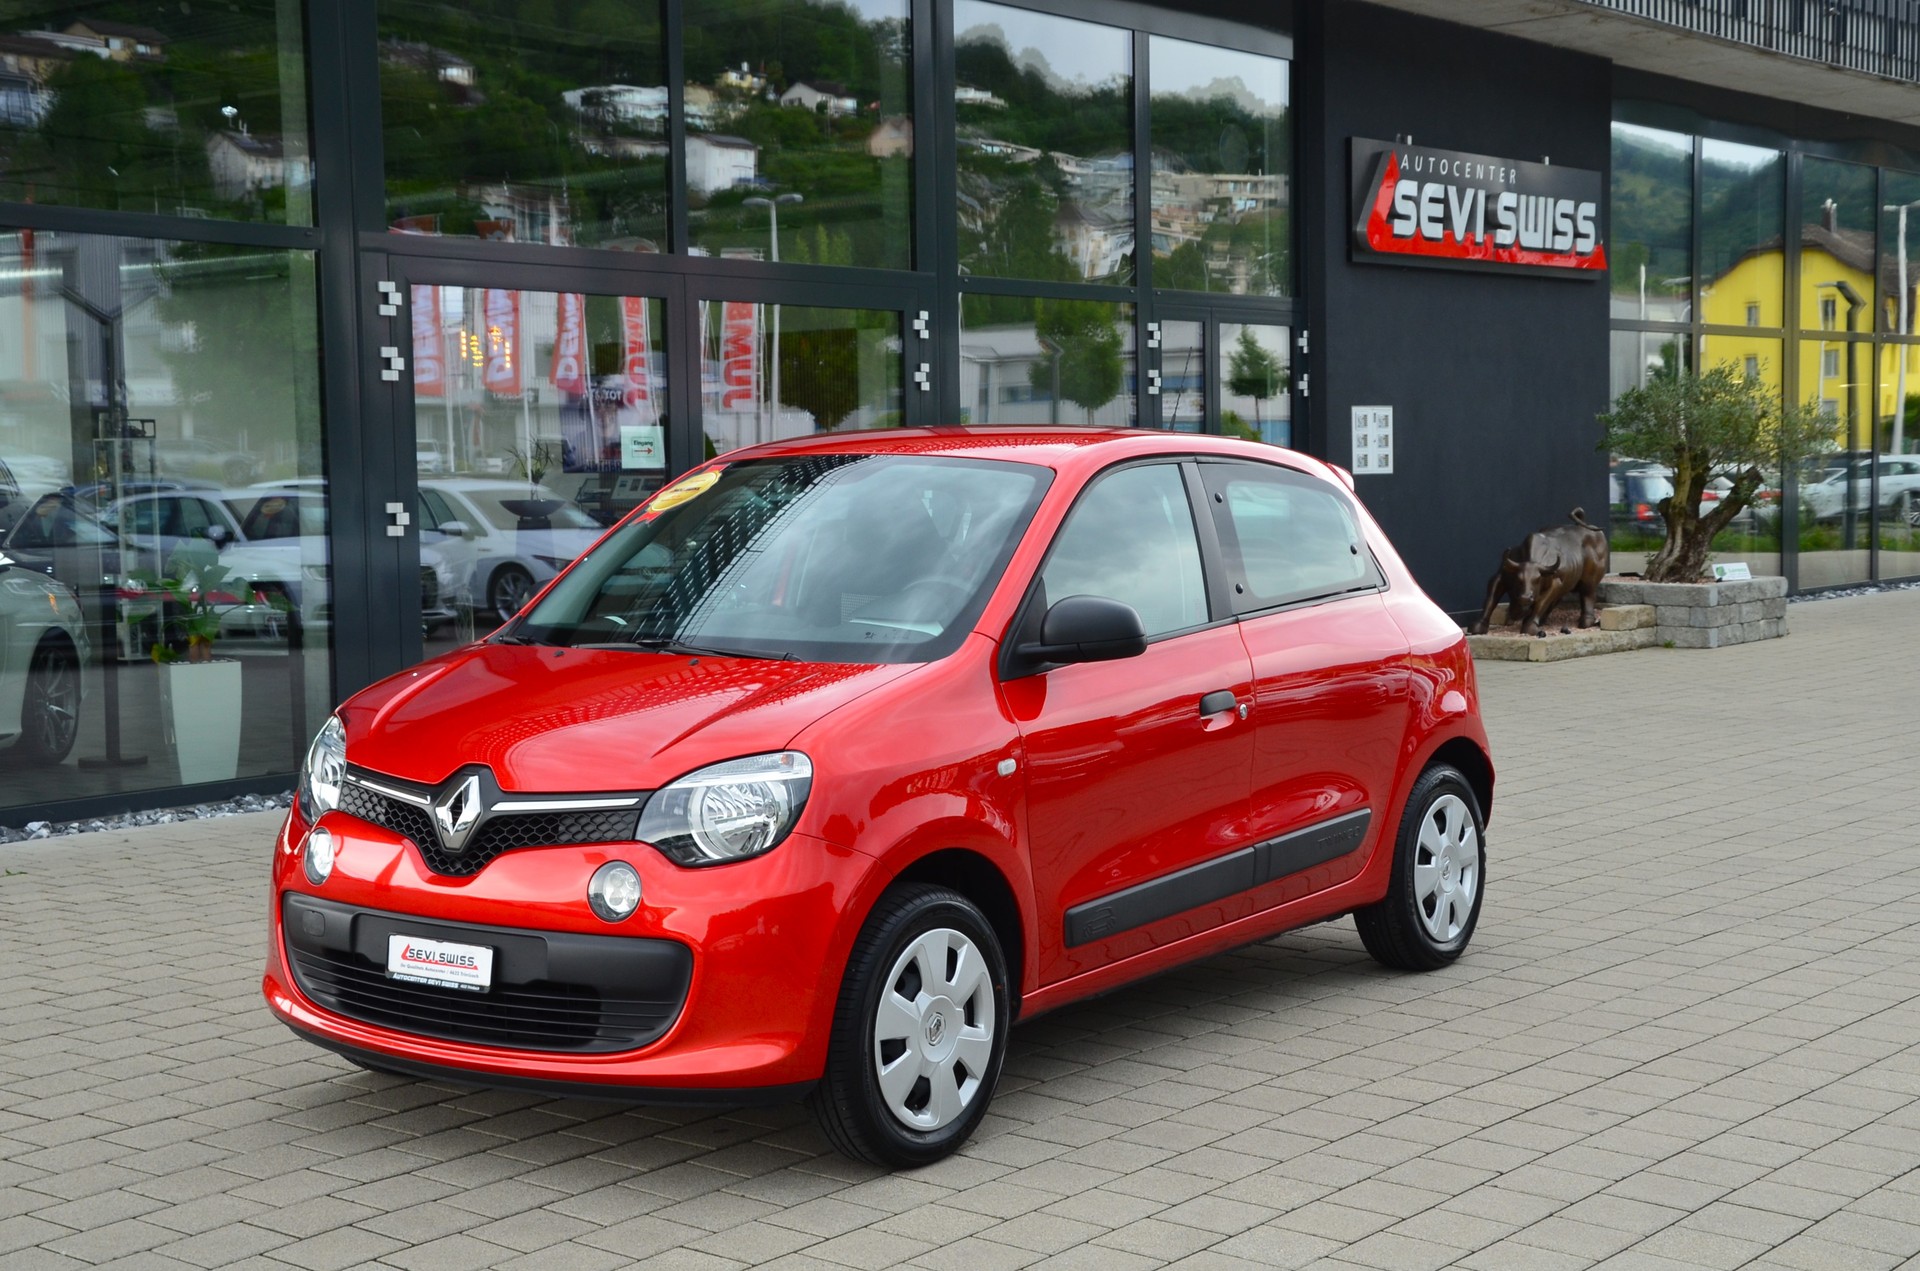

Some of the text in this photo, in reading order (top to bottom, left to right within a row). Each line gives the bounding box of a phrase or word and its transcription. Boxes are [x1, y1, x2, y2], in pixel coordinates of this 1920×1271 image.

[1400, 153, 1517, 185] AUTOCENTER
[1392, 179, 1597, 253] SEVI SWISS
[408, 948, 475, 966] SEVI SWISS
[393, 974, 428, 983] AUTOCENTER
